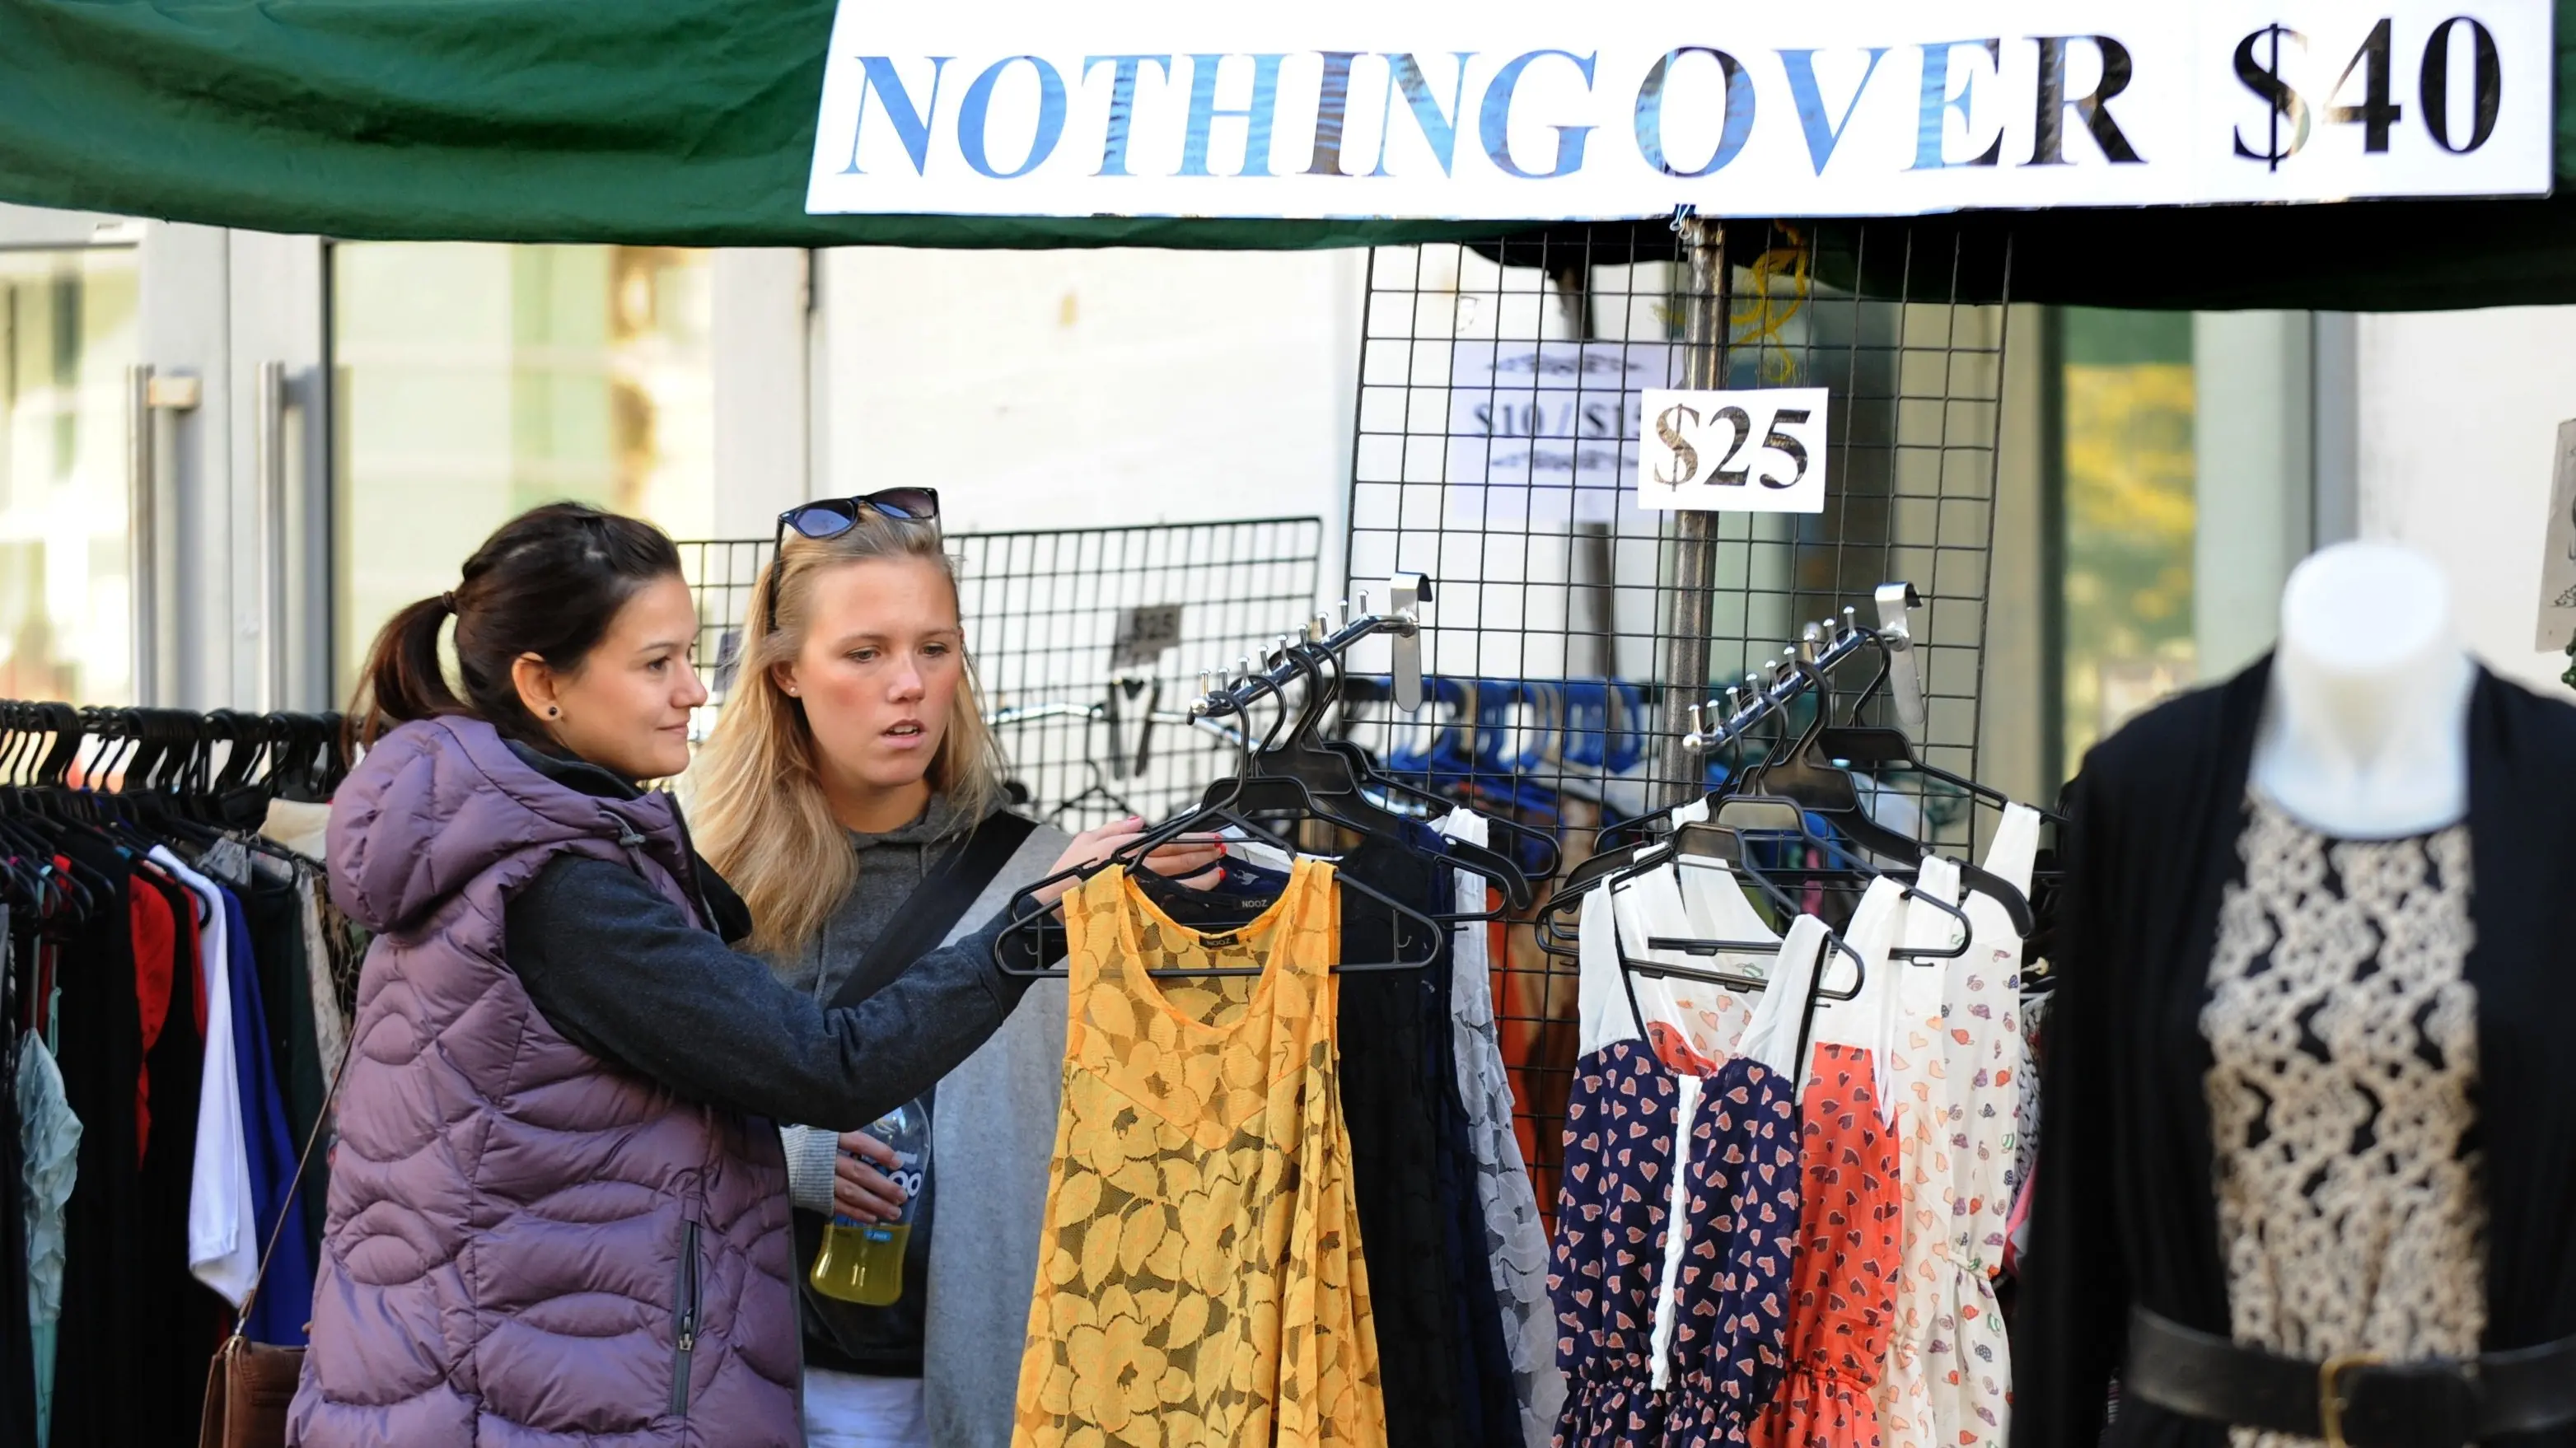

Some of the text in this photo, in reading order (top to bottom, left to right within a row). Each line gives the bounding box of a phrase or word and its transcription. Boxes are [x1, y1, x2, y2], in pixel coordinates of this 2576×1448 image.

[835, 16, 2502, 180] NOTHING OVER $40
[1472, 401, 1545, 437] $10
[1653, 403, 1812, 492] $25
[1241, 899, 1268, 908] NOOZ
